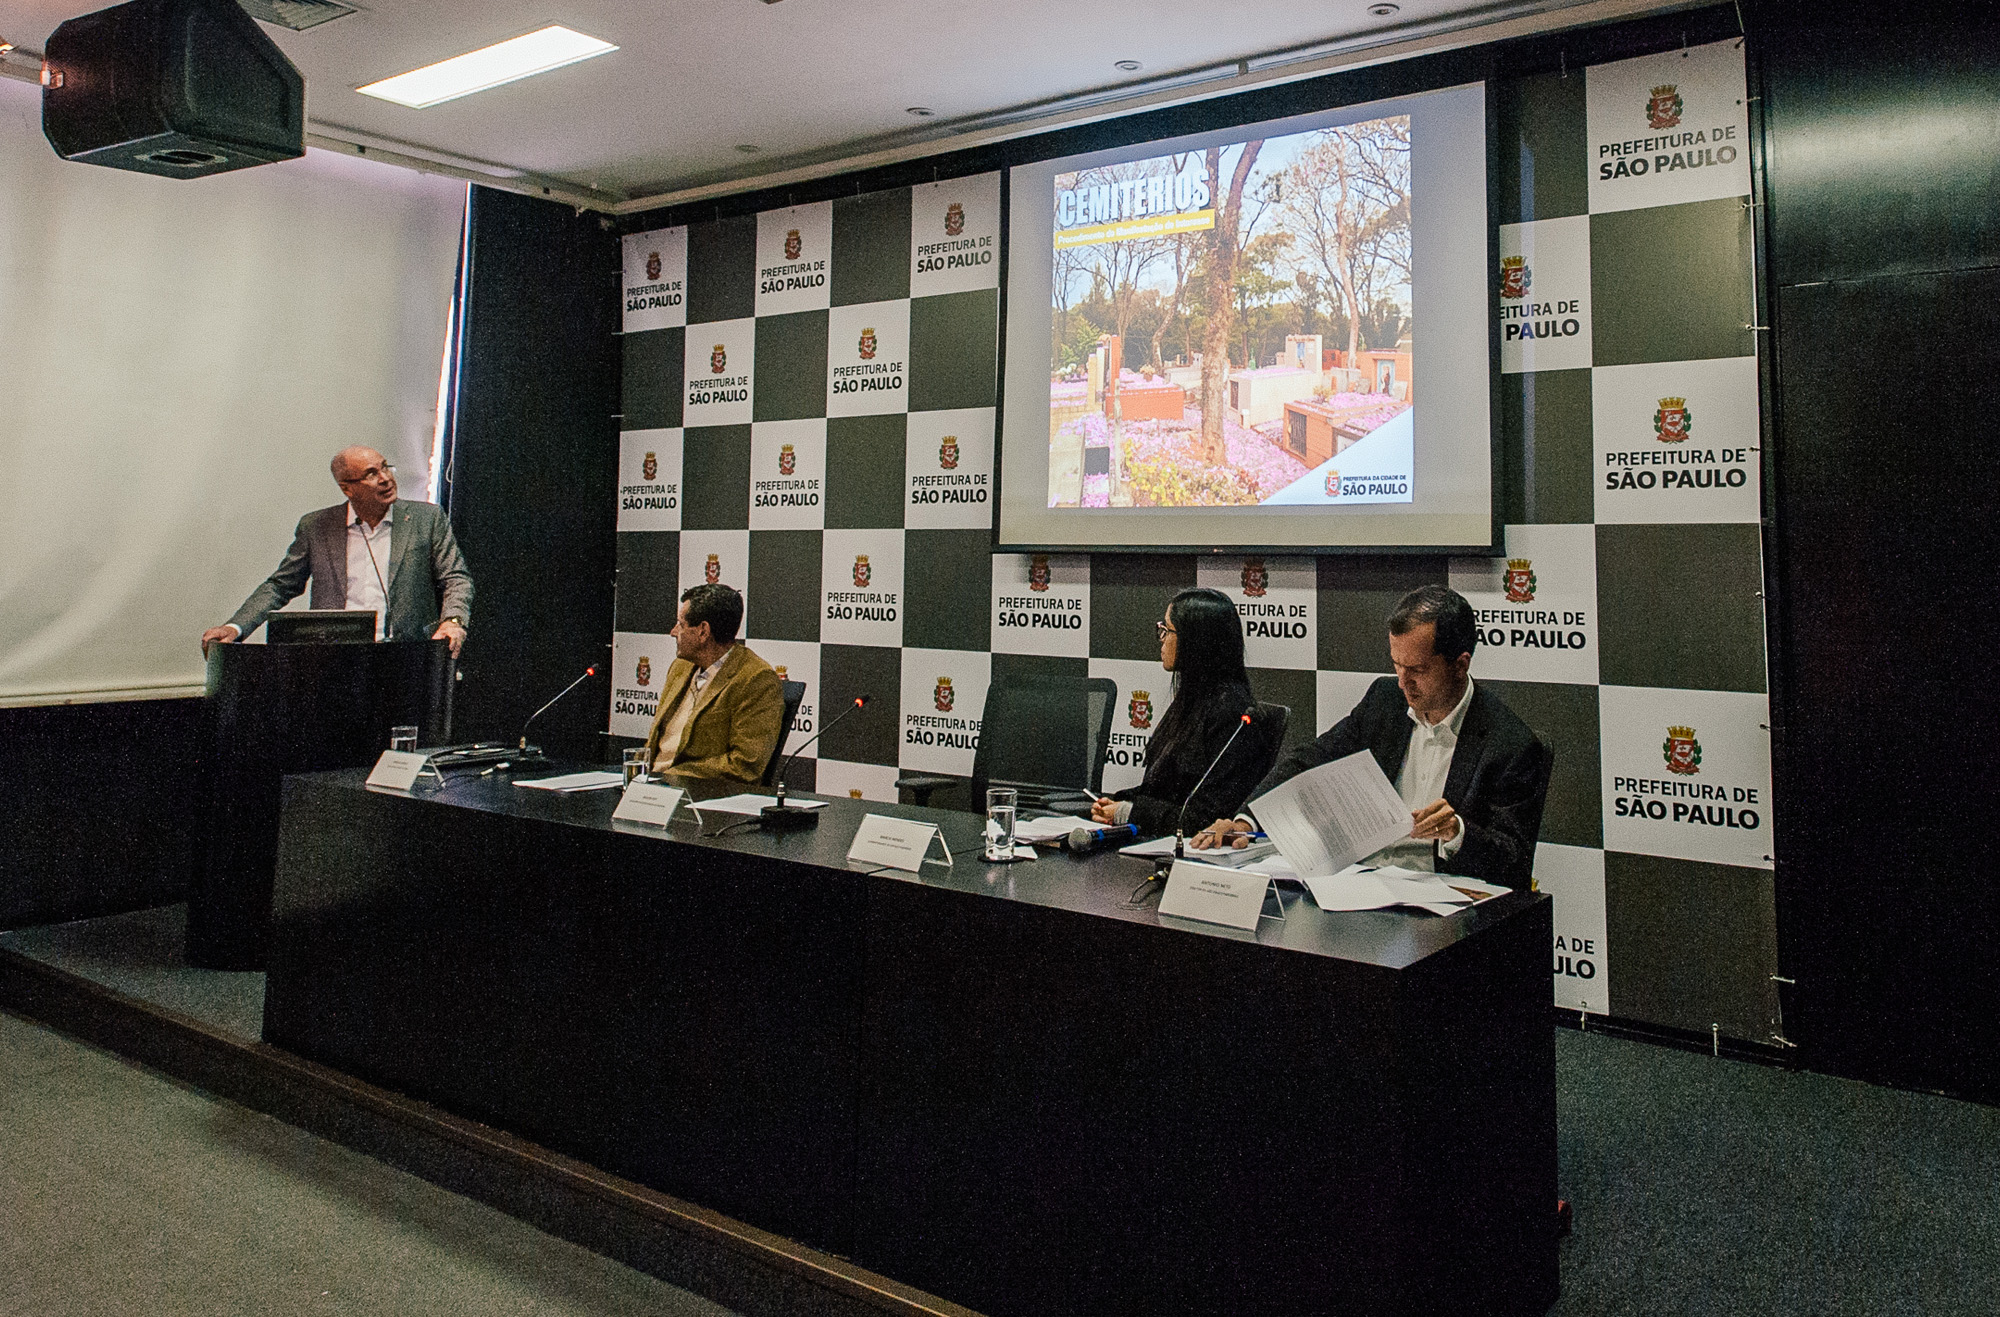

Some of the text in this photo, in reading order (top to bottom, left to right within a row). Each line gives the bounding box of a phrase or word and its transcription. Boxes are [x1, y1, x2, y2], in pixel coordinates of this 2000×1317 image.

[1600, 125, 1735, 158] PREFEITURA DE
[1600, 146, 1736, 180] SÃO PAULO
[1058, 168, 1210, 227] CEMITÉRIOS
[918, 236, 992, 256] PREFEITURA DE
[762, 261, 825, 278] PREFEITURA DE
[917, 251, 991, 273] SÃO PAULO
[627, 281, 681, 297] PREFEITURA DE
[761, 274, 824, 294] SÃO PAULO
[626, 294, 682, 312] SÃO PAULO
[1557, 300, 1579, 314] DE
[1505, 319, 1580, 341] PAULO
[834, 362, 902, 377] PREFEITURA DE
[690, 376, 748, 390] PREFEITURA DE
[833, 376, 902, 393] SÃO PAULO
[689, 389, 747, 405] SÃO PAULO
[1607, 449, 1746, 466] PREFEITURA DE
[756, 480, 819, 490] PREFEITURA DE
[913, 474, 987, 487] PREFEITURA DE
[1606, 468, 1746, 490] SÃO PAULO
[622, 484, 676, 495] PREFEITURA DE
[912, 487, 987, 504] SÃO PAULO
[1342, 482, 1408, 496] SÃO PAULO
[622, 494, 676, 510] SÃO PAULO
[755, 491, 818, 507] SÃO PAULO
[828, 592, 896, 605] PREFEITURA DE
[999, 597, 1081, 610] PREFEITURA DE
[827, 604, 896, 621] SÃO PAULO
[999, 609, 1081, 629] SÃO PAULO
[1289, 605, 1307, 618] DE
[1563, 612, 1586, 626] DE
[1246, 621, 1307, 639] PAULO
[1510, 629, 1586, 649] PAULO
[616, 688, 659, 701] PREFEITURA
[615, 699, 636, 715] SÃO
[801, 705, 813, 715] DE
[906, 714, 982, 731] PREFEITURA DE
[906, 727, 934, 745] SÃO
[1615, 777, 1758, 804] PREFEITURA DE
[1615, 795, 1759, 830] SÃO PAULO
[1571, 937, 1594, 955] DE
